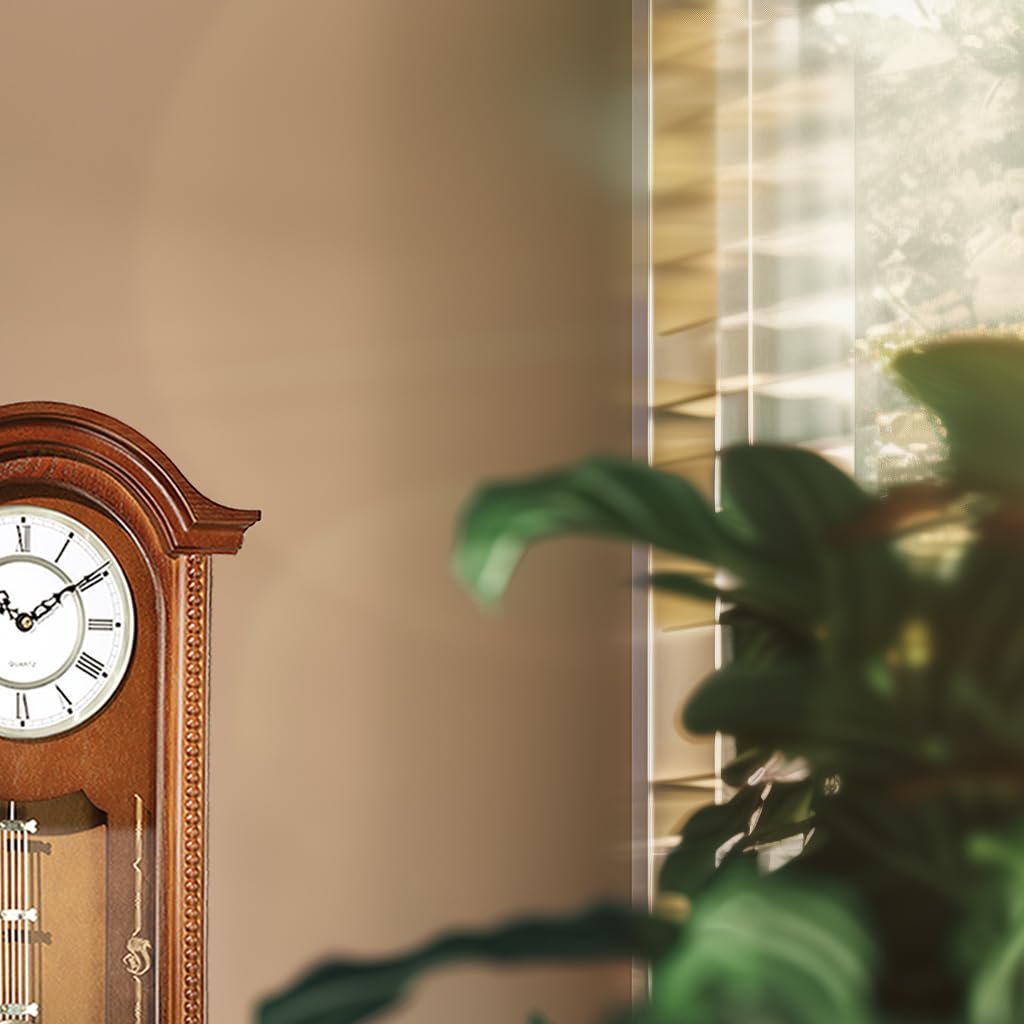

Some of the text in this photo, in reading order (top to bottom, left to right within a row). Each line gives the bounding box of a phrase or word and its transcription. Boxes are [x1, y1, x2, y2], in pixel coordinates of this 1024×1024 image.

[55, 539, 70, 563] I
[88, 618, 113, 631] III
[75, 651, 105, 680] IIII
[15, 692, 30, 720] VI
[55, 684, 72, 709] V
